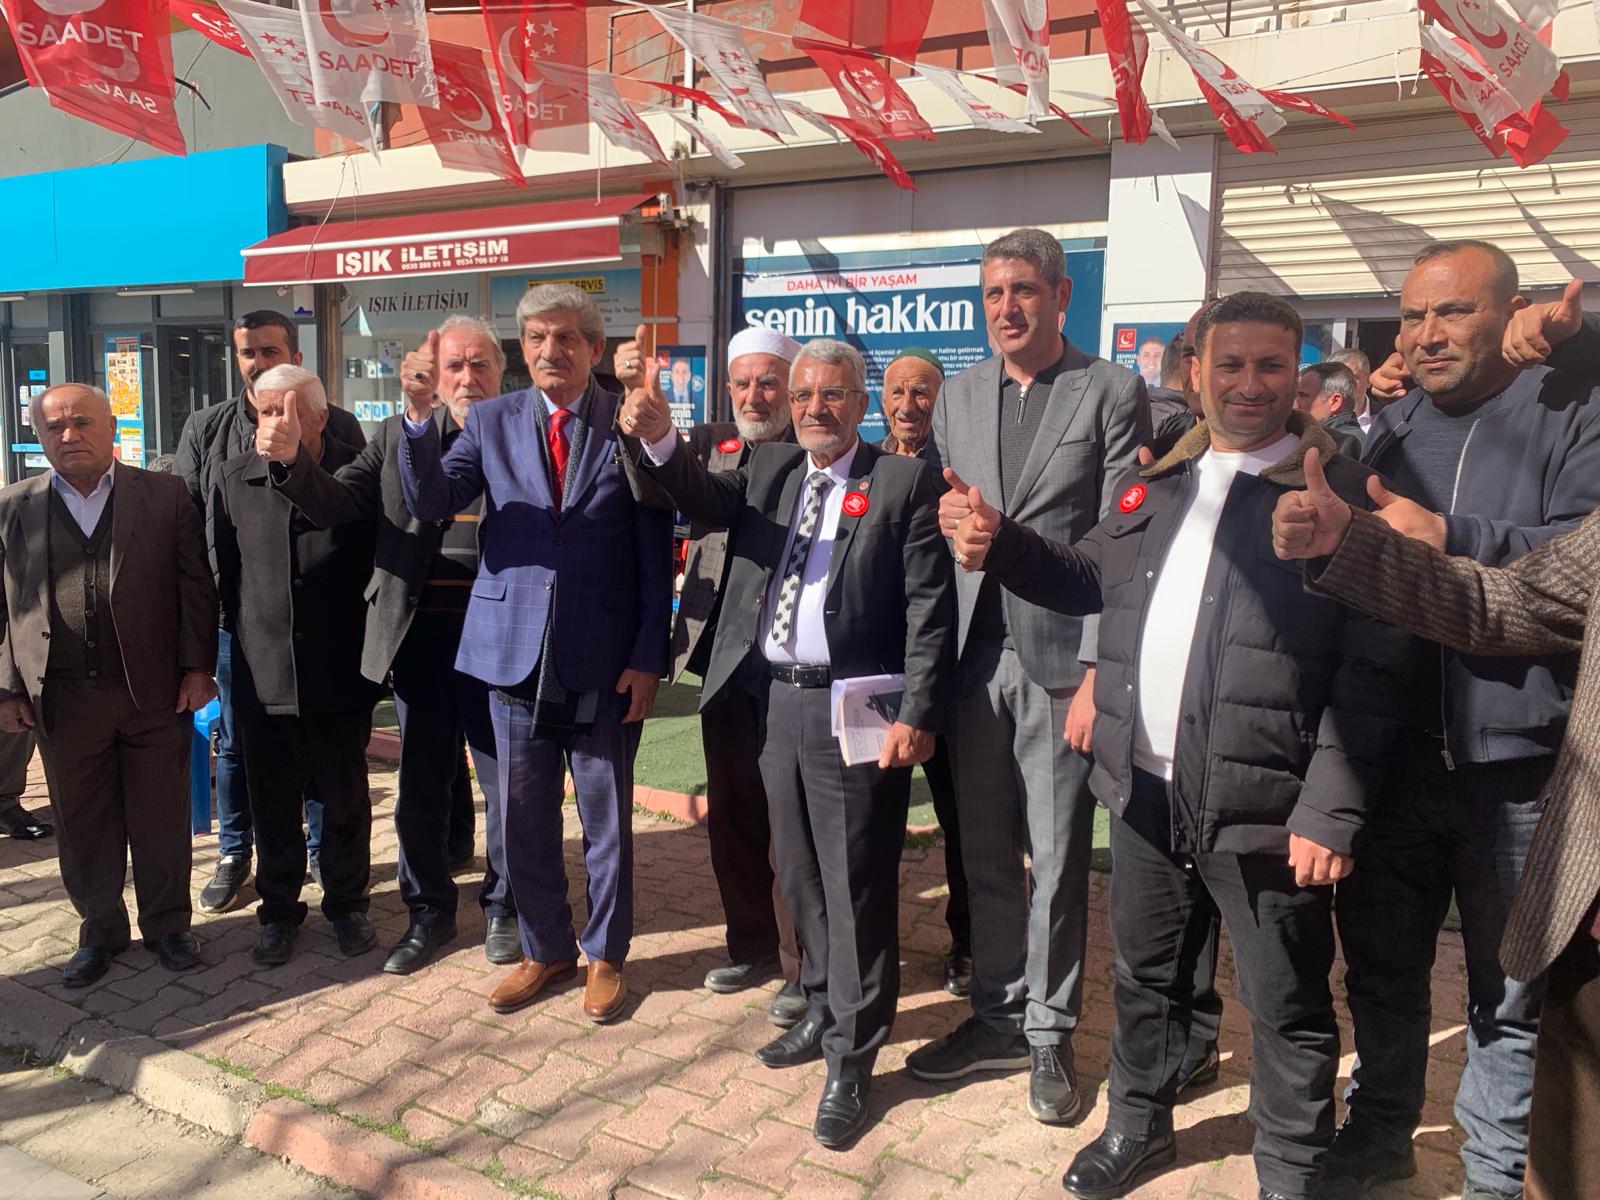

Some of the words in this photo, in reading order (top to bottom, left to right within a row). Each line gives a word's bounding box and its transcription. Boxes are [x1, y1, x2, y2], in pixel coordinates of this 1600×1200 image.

[17, 22, 144, 53] SAADET
[318, 51, 418, 79] SAADET
[336, 249, 392, 276] IŞIK
[786, 278, 822, 292] DAHA
[827, 273, 842, 288] İYİ
[845, 273, 867, 287] BİR
[871, 273, 917, 287] YAŞAM
[368, 296, 398, 315] IŞIK
[401, 290, 469, 312] İLETİŞİM
[745, 297, 836, 337] senin
[846, 293, 974, 335] hakkın
